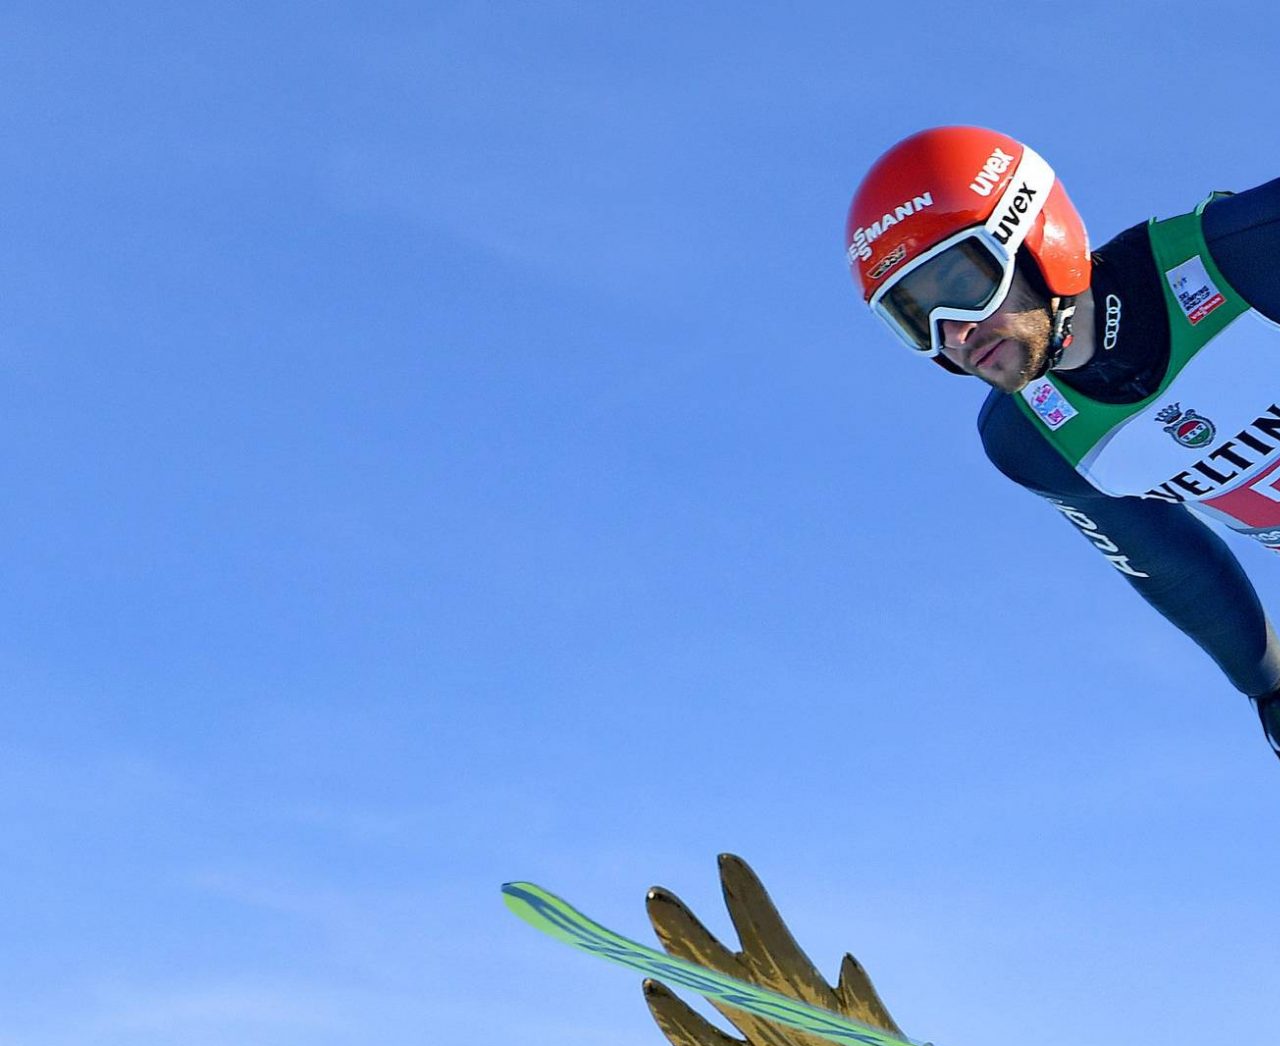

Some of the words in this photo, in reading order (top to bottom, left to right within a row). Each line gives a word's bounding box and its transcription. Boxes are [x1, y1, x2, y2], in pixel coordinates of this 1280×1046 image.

[969, 147, 1015, 197] uvex
[848, 191, 934, 264] ESSMANN
[992, 181, 1037, 246] uvex
